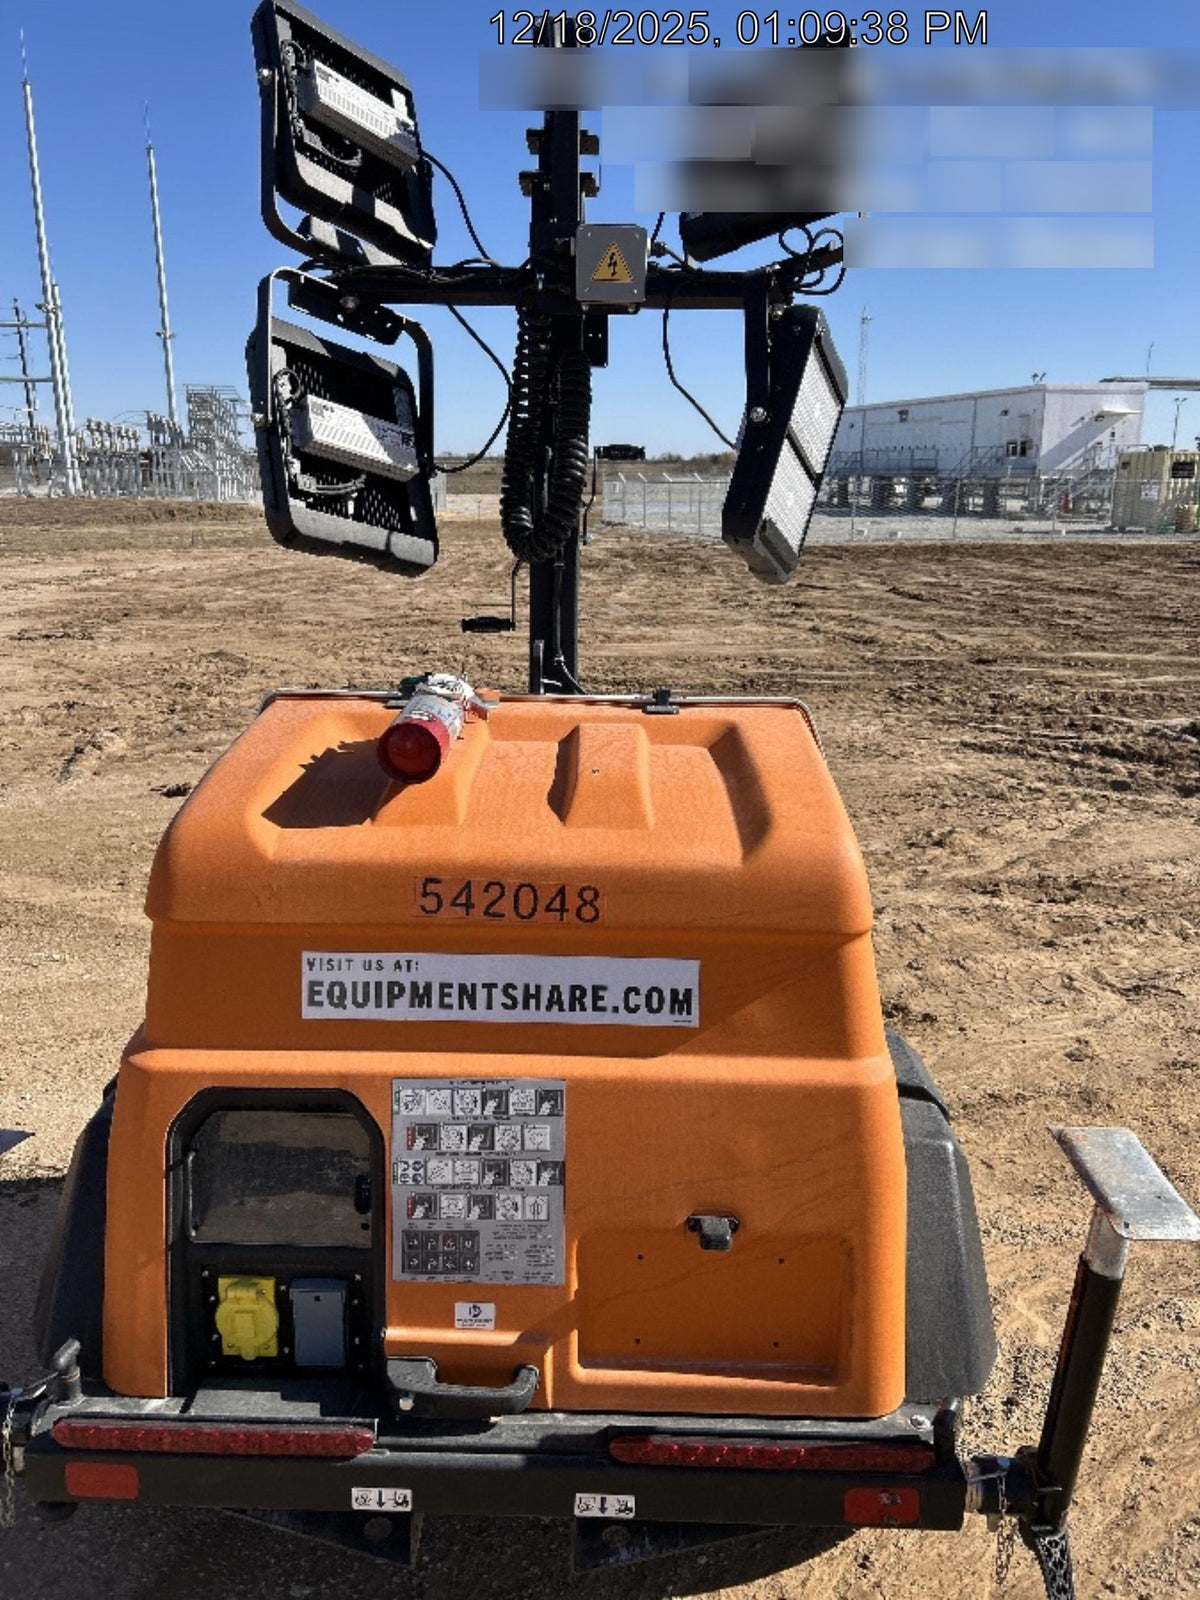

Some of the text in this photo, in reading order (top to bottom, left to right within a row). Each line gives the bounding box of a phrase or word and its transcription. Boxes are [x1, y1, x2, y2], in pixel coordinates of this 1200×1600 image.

[419, 877, 601, 923] 542048
[306, 957, 420, 973] VISIT US AT:
[306, 980, 694, 1017] EQUIPMENTSHARE.COM
